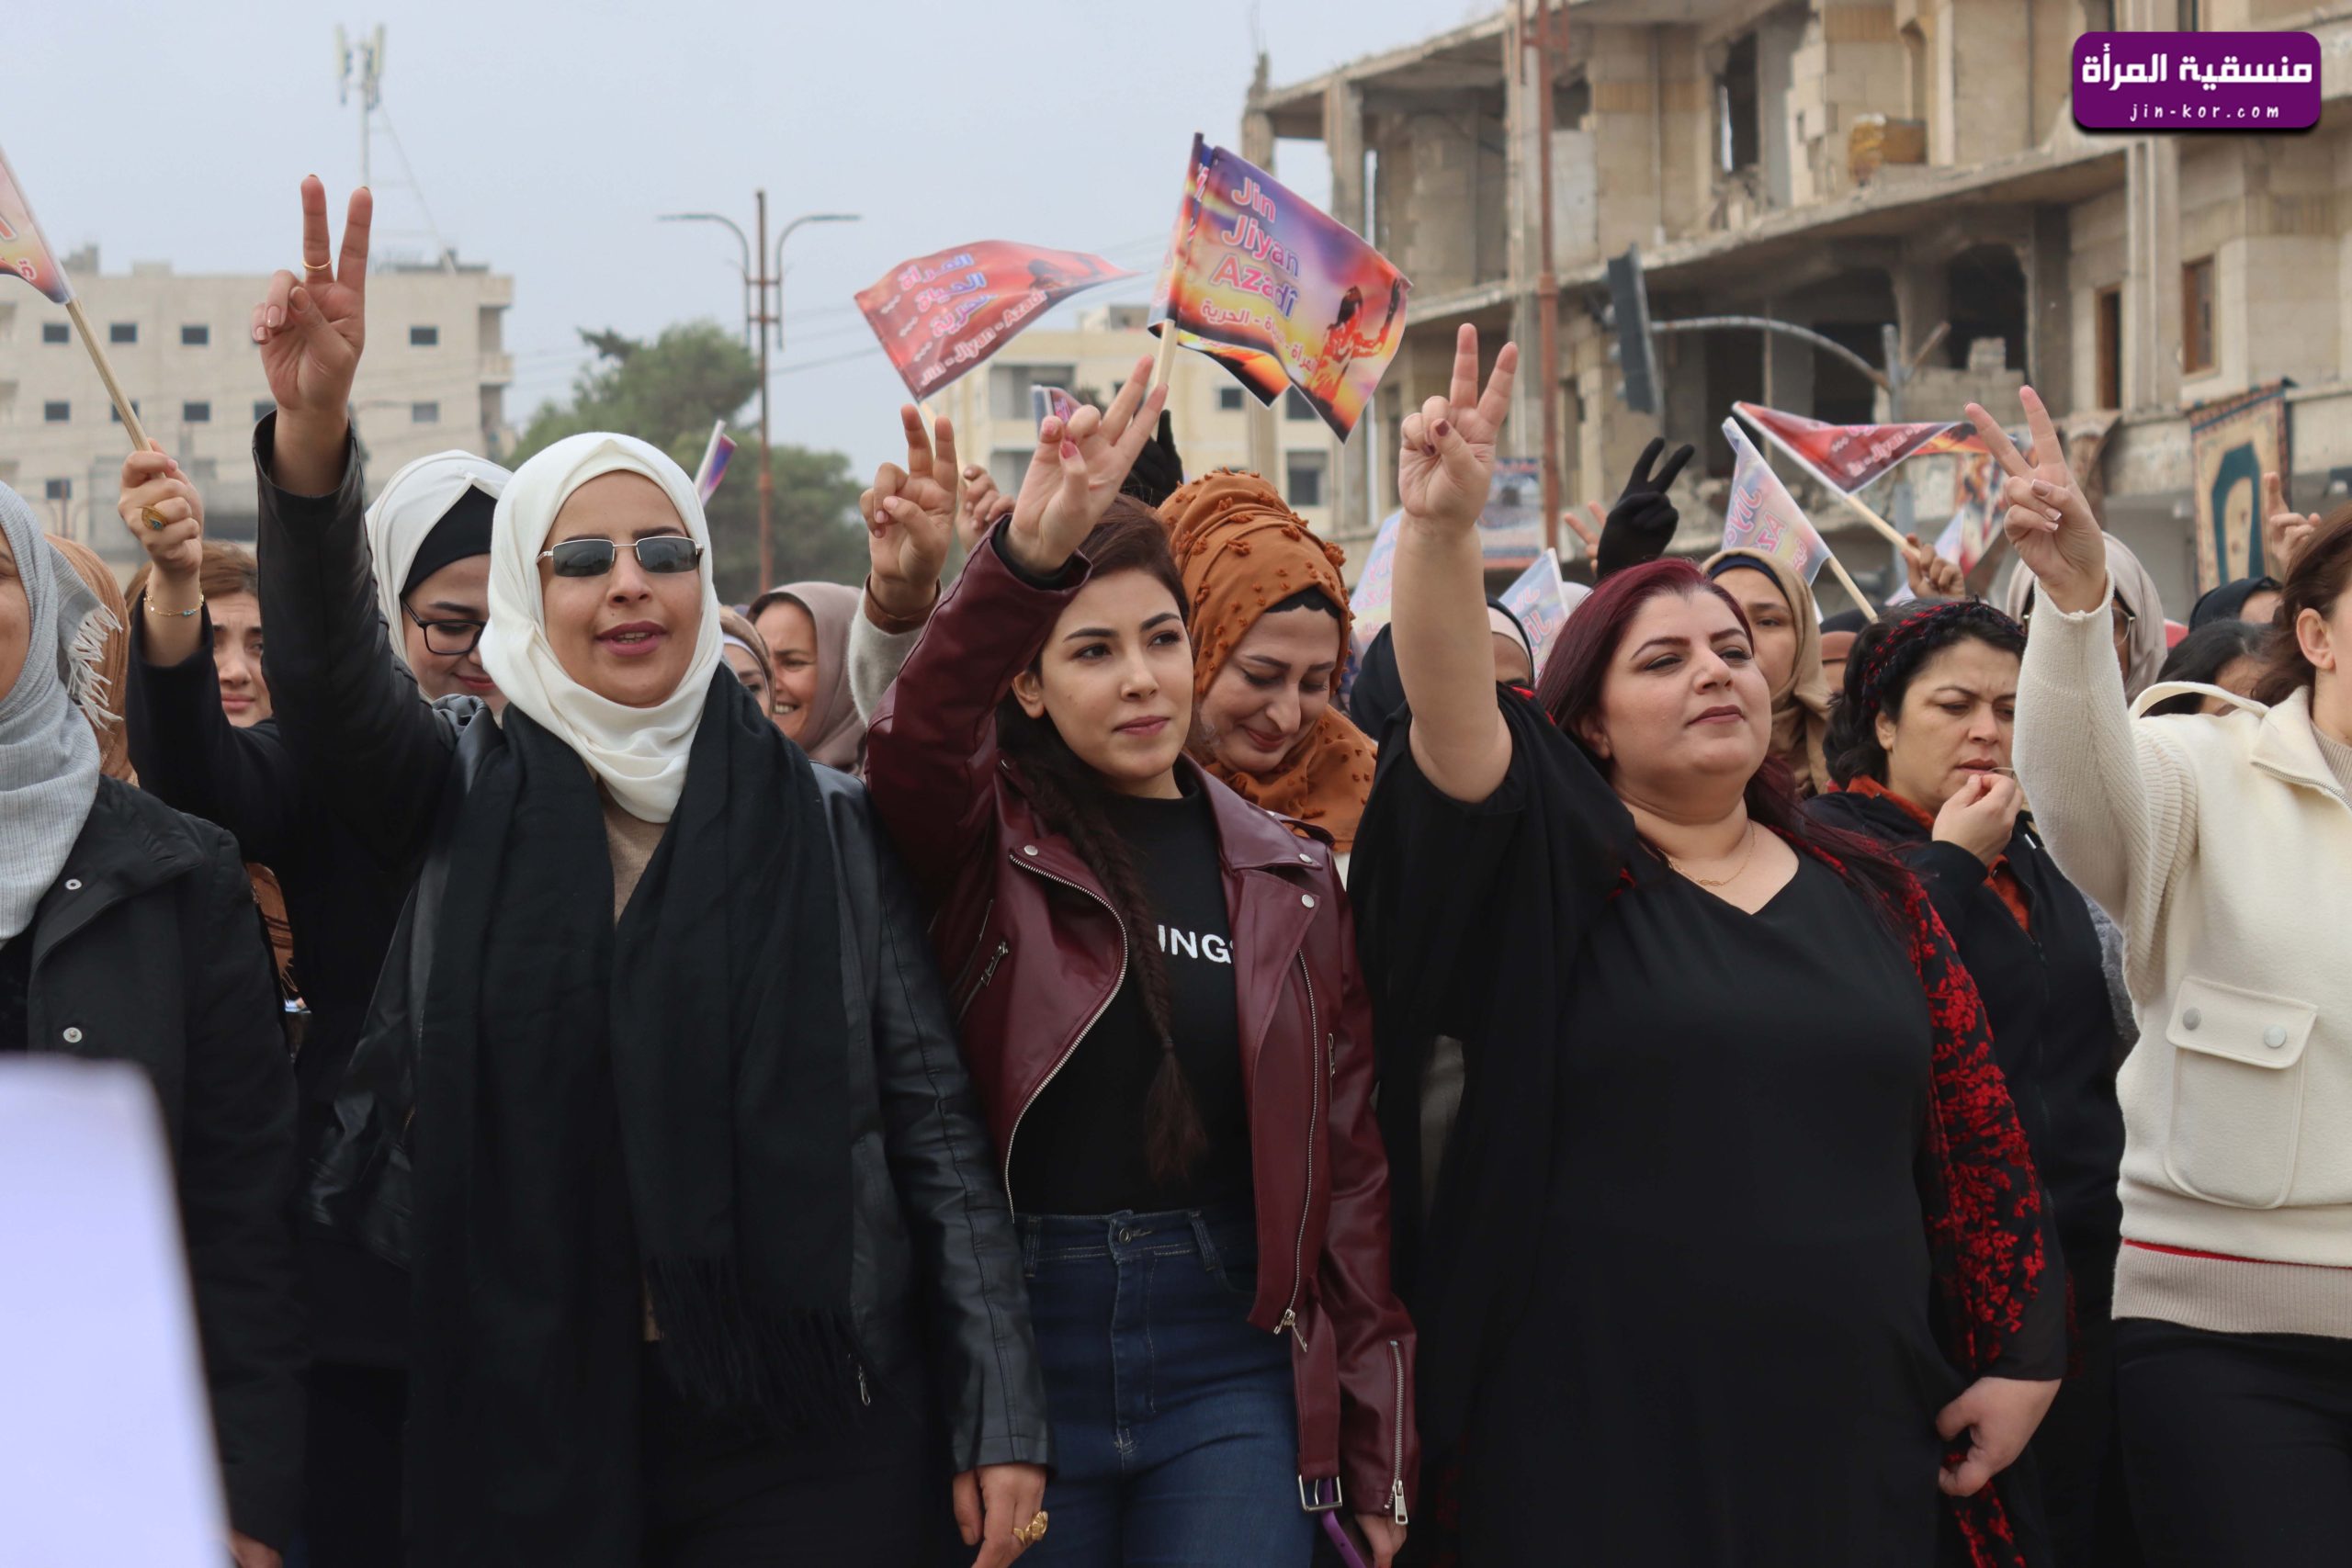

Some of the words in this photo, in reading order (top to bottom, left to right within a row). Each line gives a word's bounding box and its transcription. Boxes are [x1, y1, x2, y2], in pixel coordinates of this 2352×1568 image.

[1231, 177, 1276, 222] Jin
[1222, 215, 1299, 276] Jiyan
[1158, 924, 1234, 964] ING
